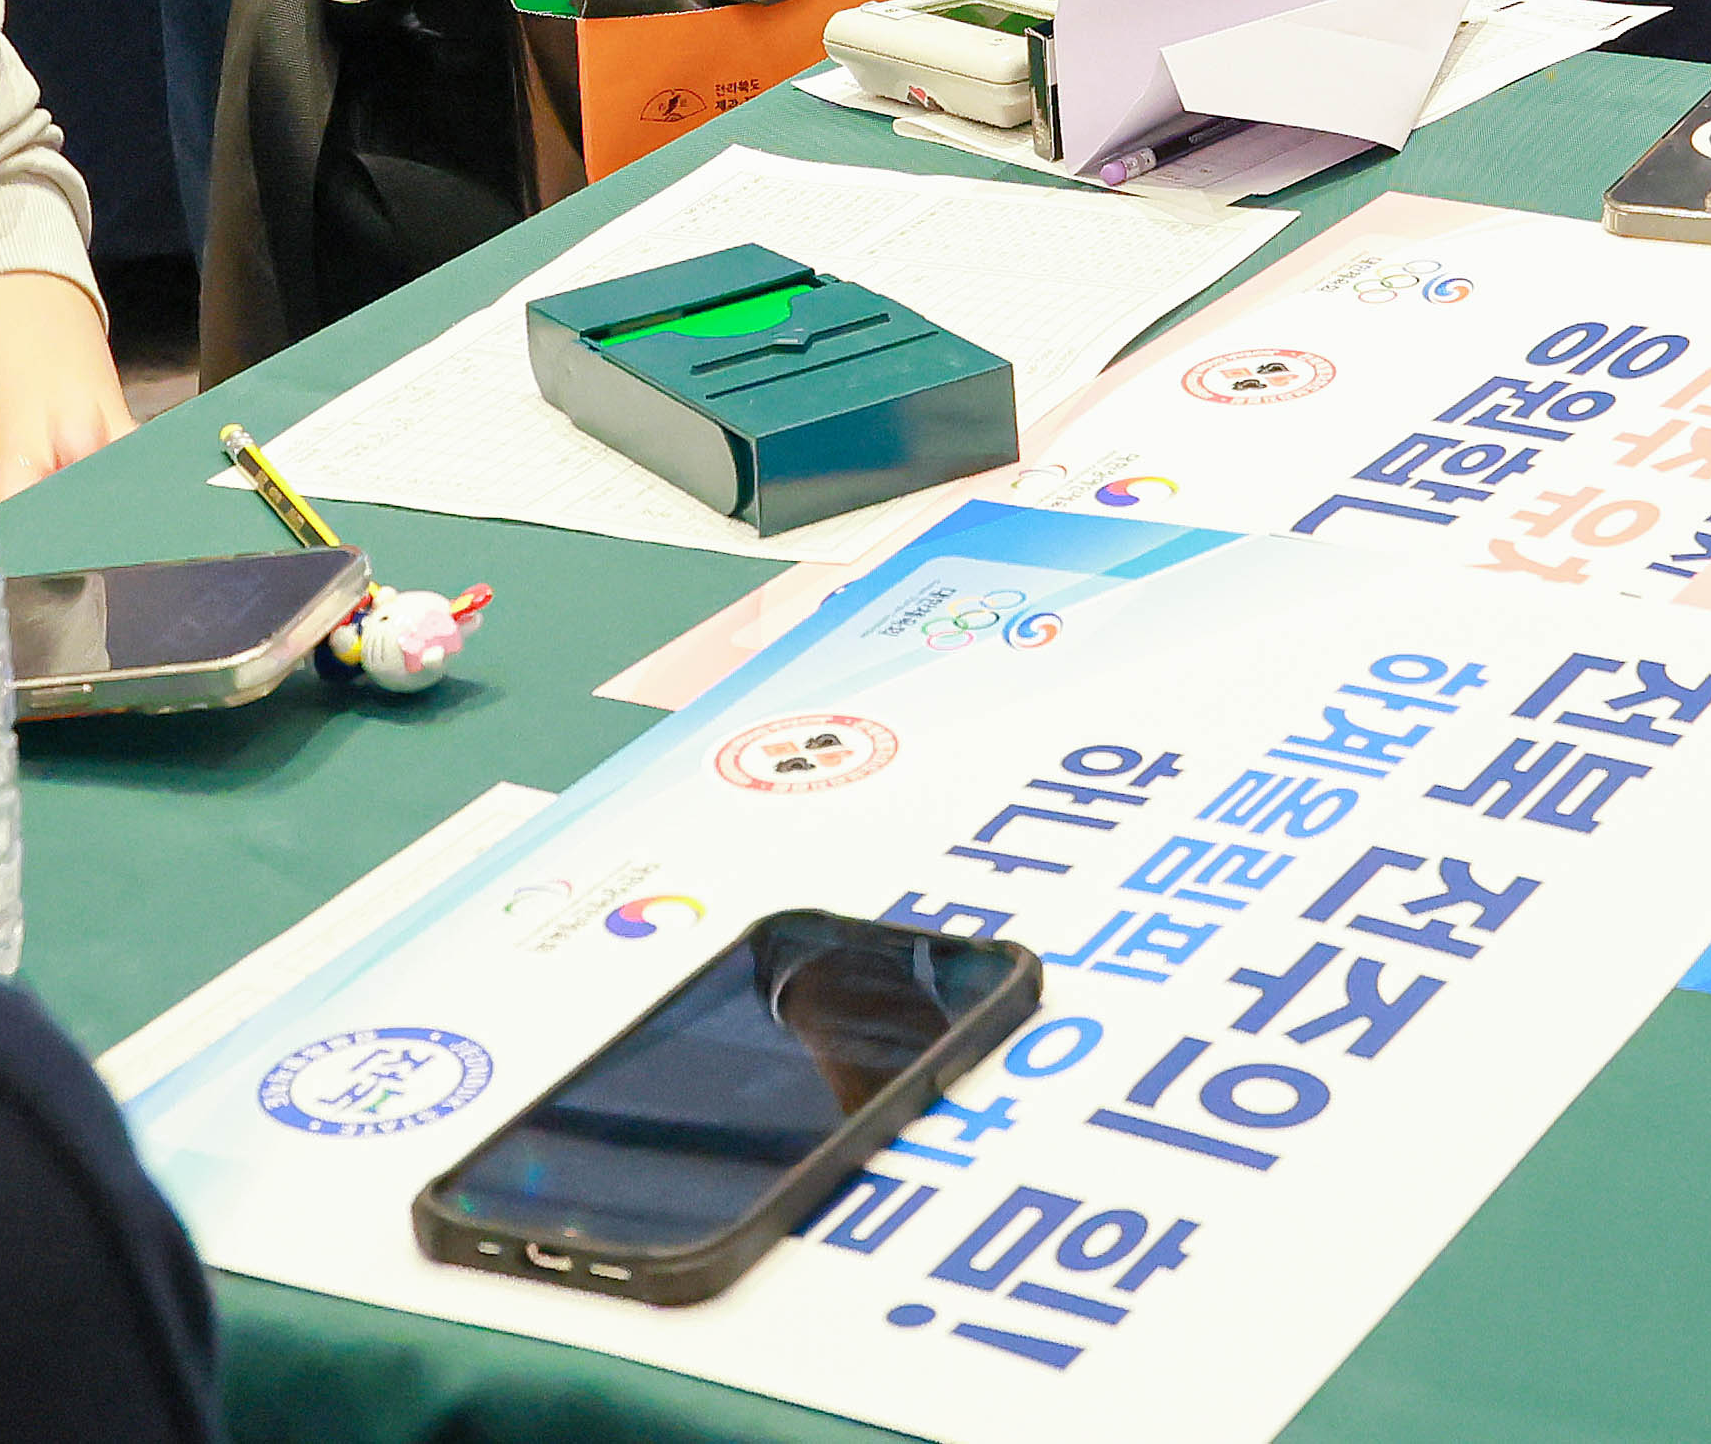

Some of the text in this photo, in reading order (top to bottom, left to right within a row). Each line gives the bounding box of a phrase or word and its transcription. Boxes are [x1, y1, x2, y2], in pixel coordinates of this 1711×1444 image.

[946, 742, 1185, 875] 하나
[1042, 652, 1489, 984] 하계올림픽
[1089, 846, 1542, 1171] 전주의
[886, 1184, 1201, 1370] 힘!
